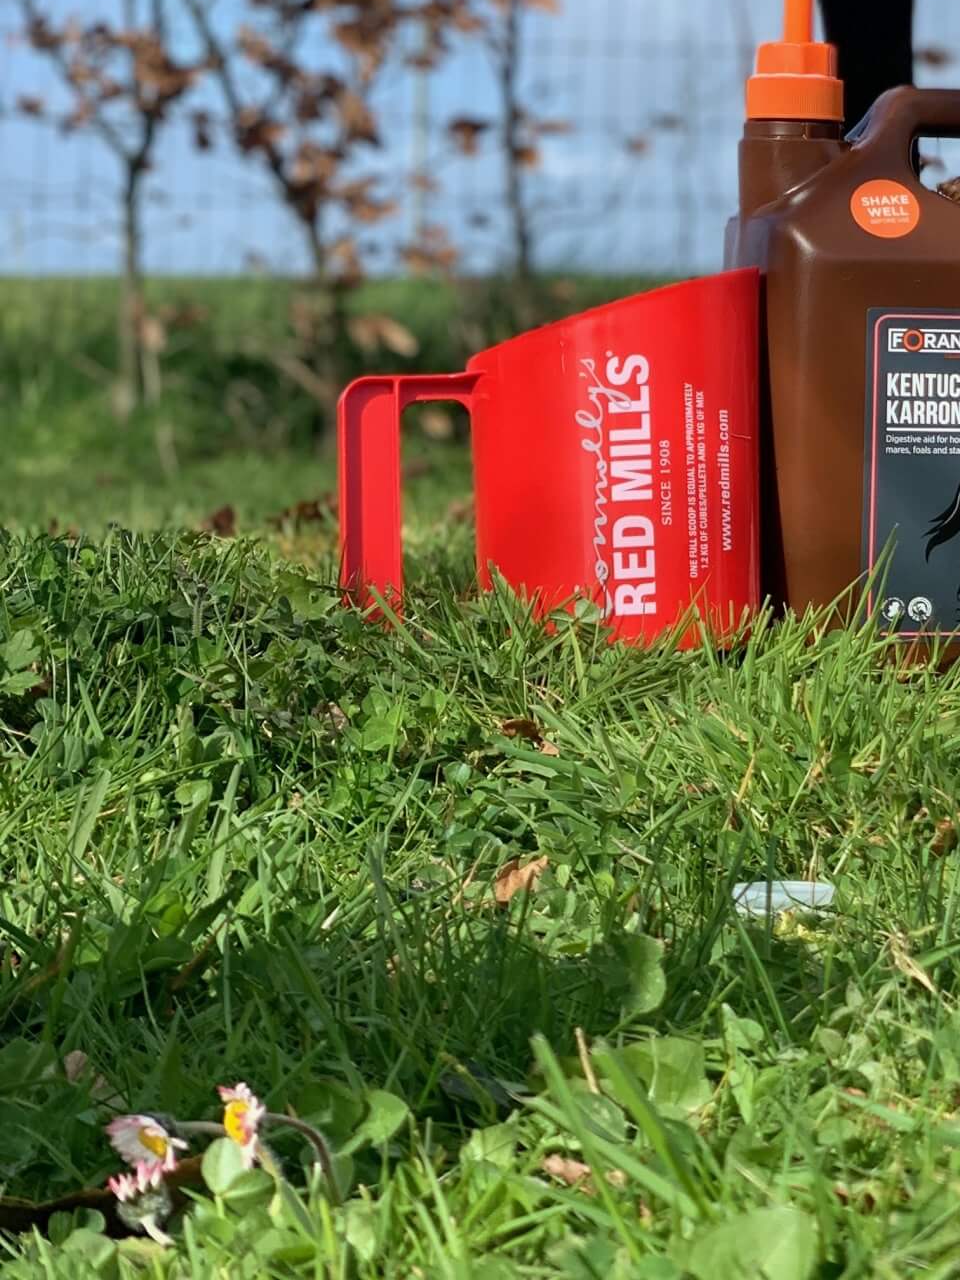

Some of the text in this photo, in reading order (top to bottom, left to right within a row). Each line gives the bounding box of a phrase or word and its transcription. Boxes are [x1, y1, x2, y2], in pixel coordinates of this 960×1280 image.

[861, 194, 910, 207] SHAKE
[867, 206, 910, 217] WELL
[695, 391, 704, 408] MIX
[696, 409, 704, 421] OF
[696, 422, 705, 435] KG
[885, 434, 922, 445] Digestive
[922, 434, 935, 444] aid
[936, 434, 948, 444] for
[697, 442, 706, 461] AND
[912, 445, 931, 455] foals
[932, 446, 948, 455] and
[606, 354, 657, 616] RED MILLS
[659, 440, 672, 526] SINCE 1908
[684, 382, 698, 578] ONE FULL SCOOP IS EQUAL TO APPROXIMATELY
[717, 409, 732, 551] www.redmills.com
[697, 463, 708, 529] CUBES/PELLETS
[699, 530, 708, 542] OF
[700, 543, 708, 556] KG
